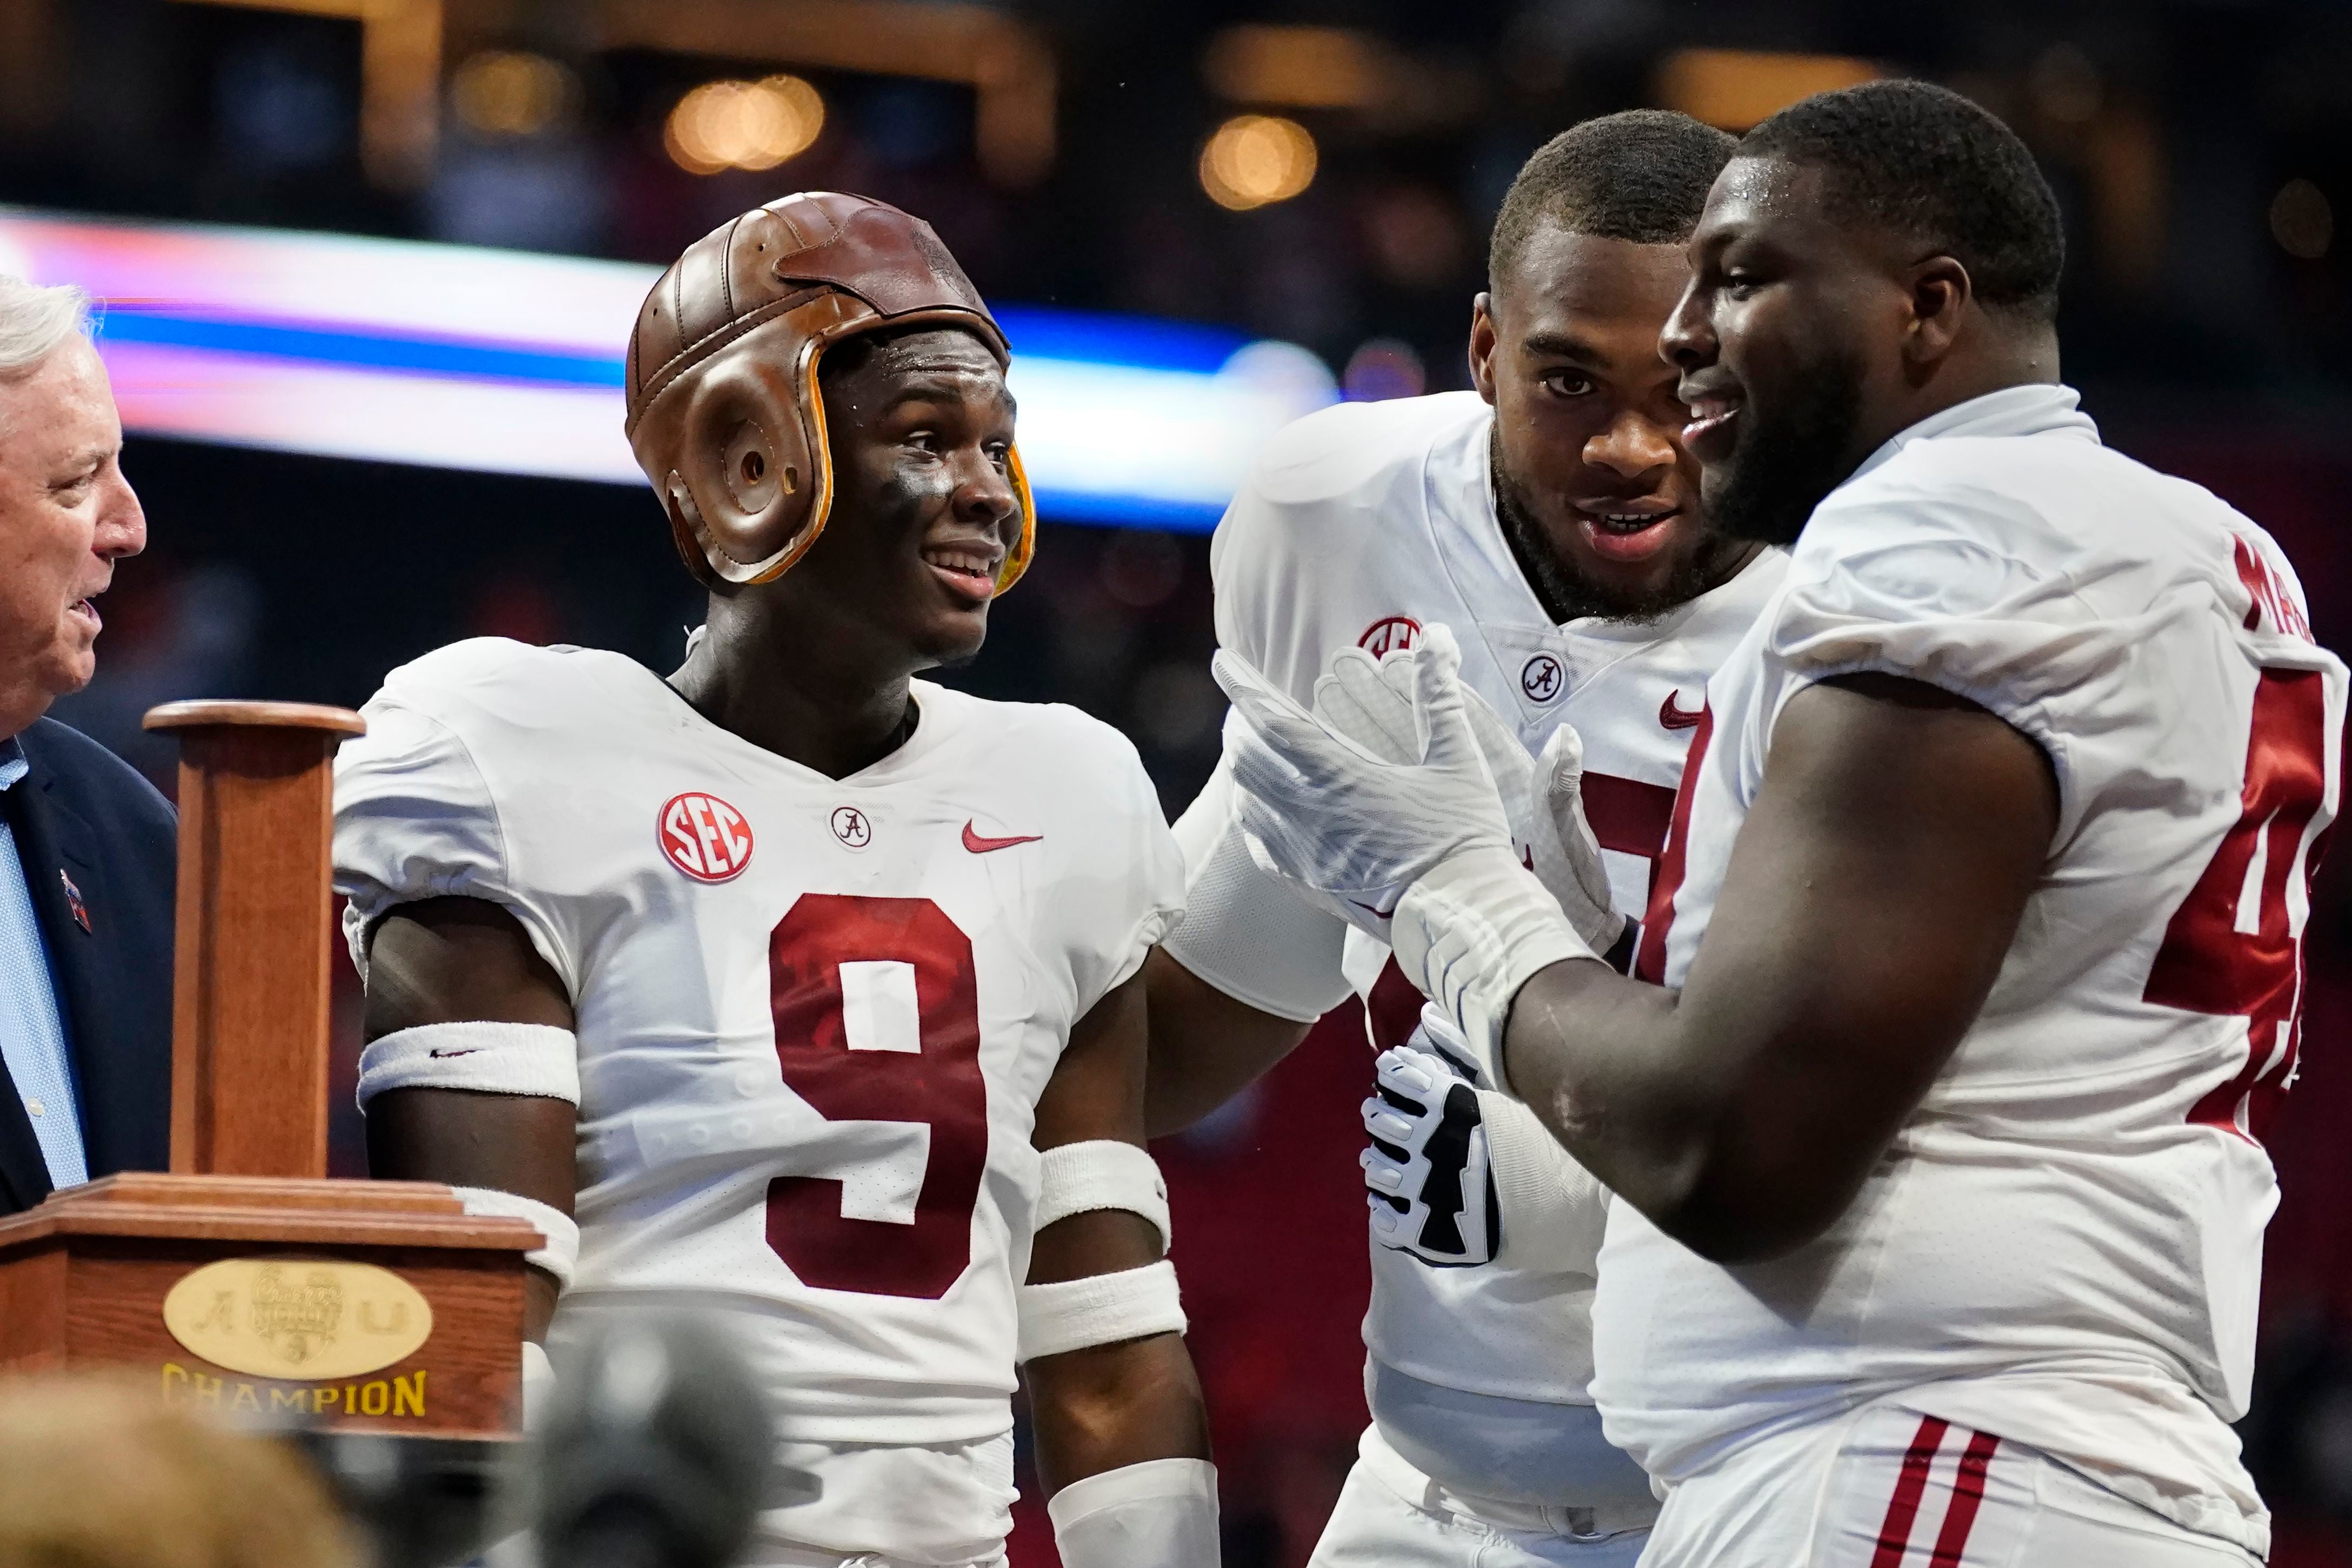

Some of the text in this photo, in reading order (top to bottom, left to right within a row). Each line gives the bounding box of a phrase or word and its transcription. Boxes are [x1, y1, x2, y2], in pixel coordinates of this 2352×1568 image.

[665, 796, 749, 875] SEC
[765, 892, 988, 1300] 9
[162, 1362, 427, 1418] CHAMPION
